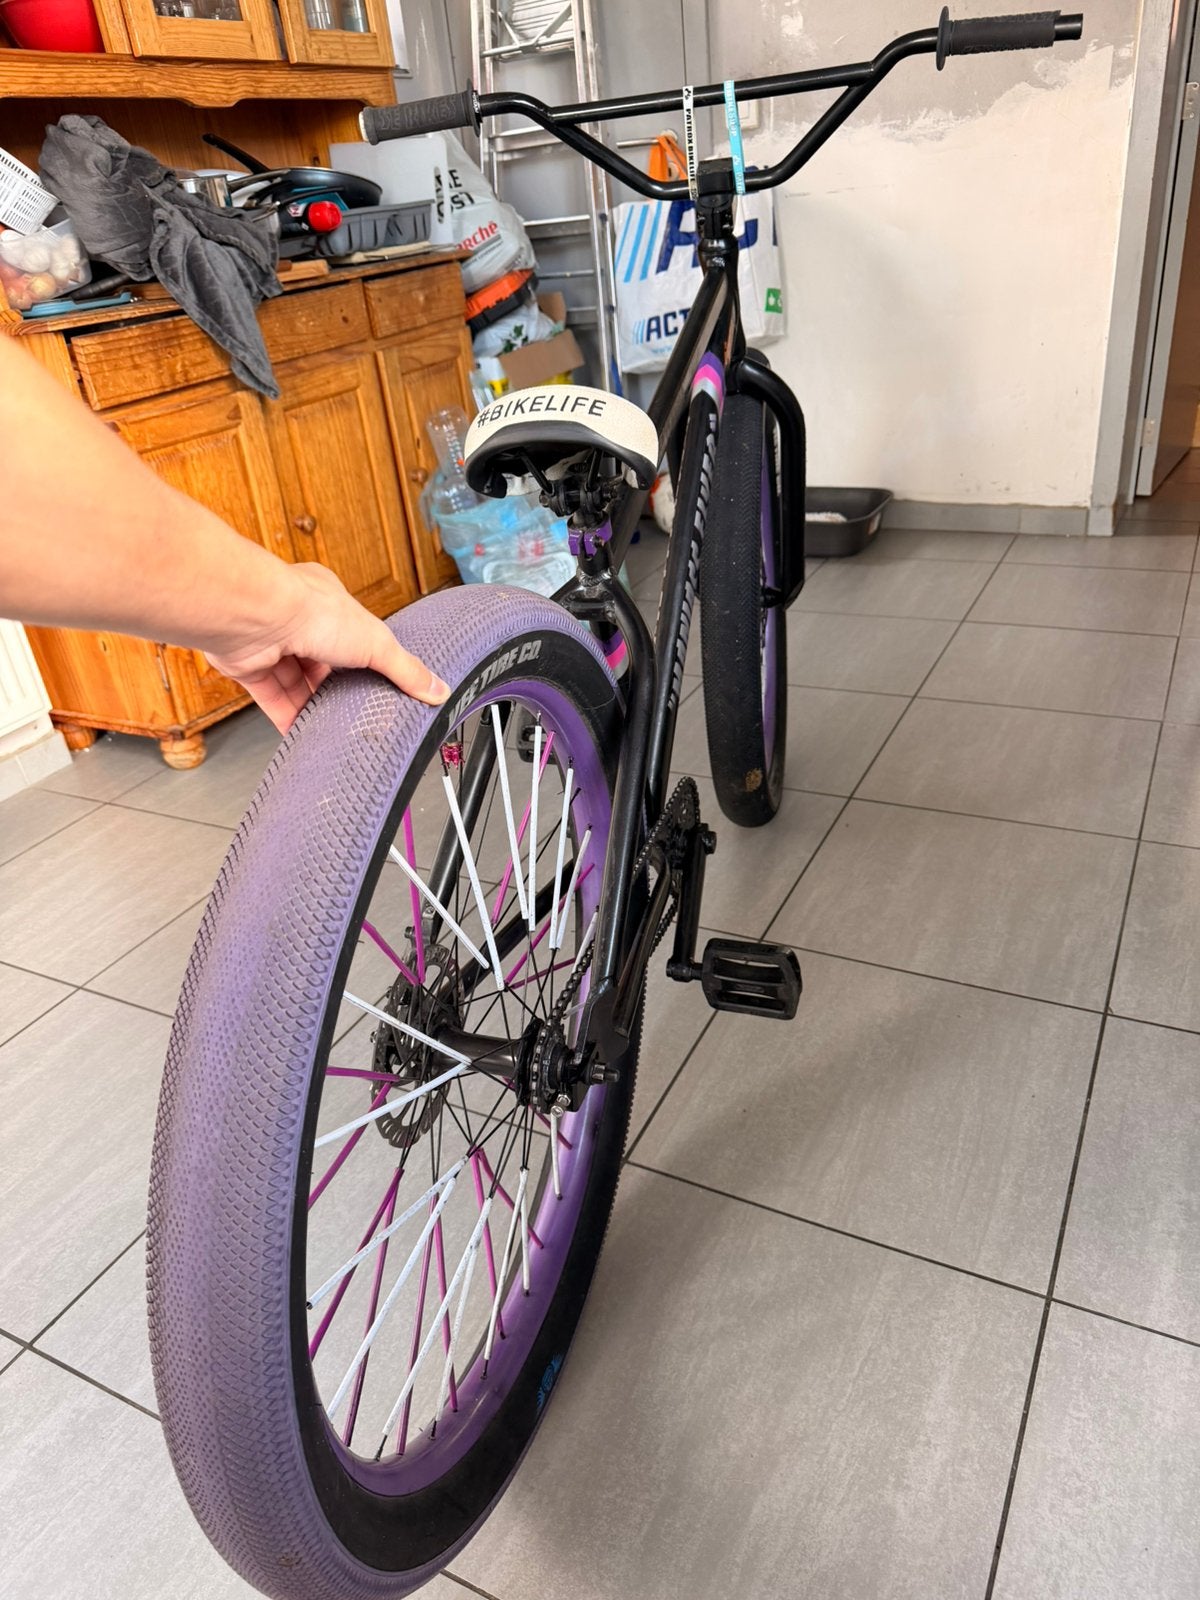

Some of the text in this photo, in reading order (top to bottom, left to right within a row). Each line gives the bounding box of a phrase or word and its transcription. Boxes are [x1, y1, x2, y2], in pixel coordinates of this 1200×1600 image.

[685, 108, 693, 144] PATROX
[688, 146, 696, 181] BIKELIFE
[477, 394, 607, 429] #BIKELIFE
[480, 646, 520, 692] TIRE
